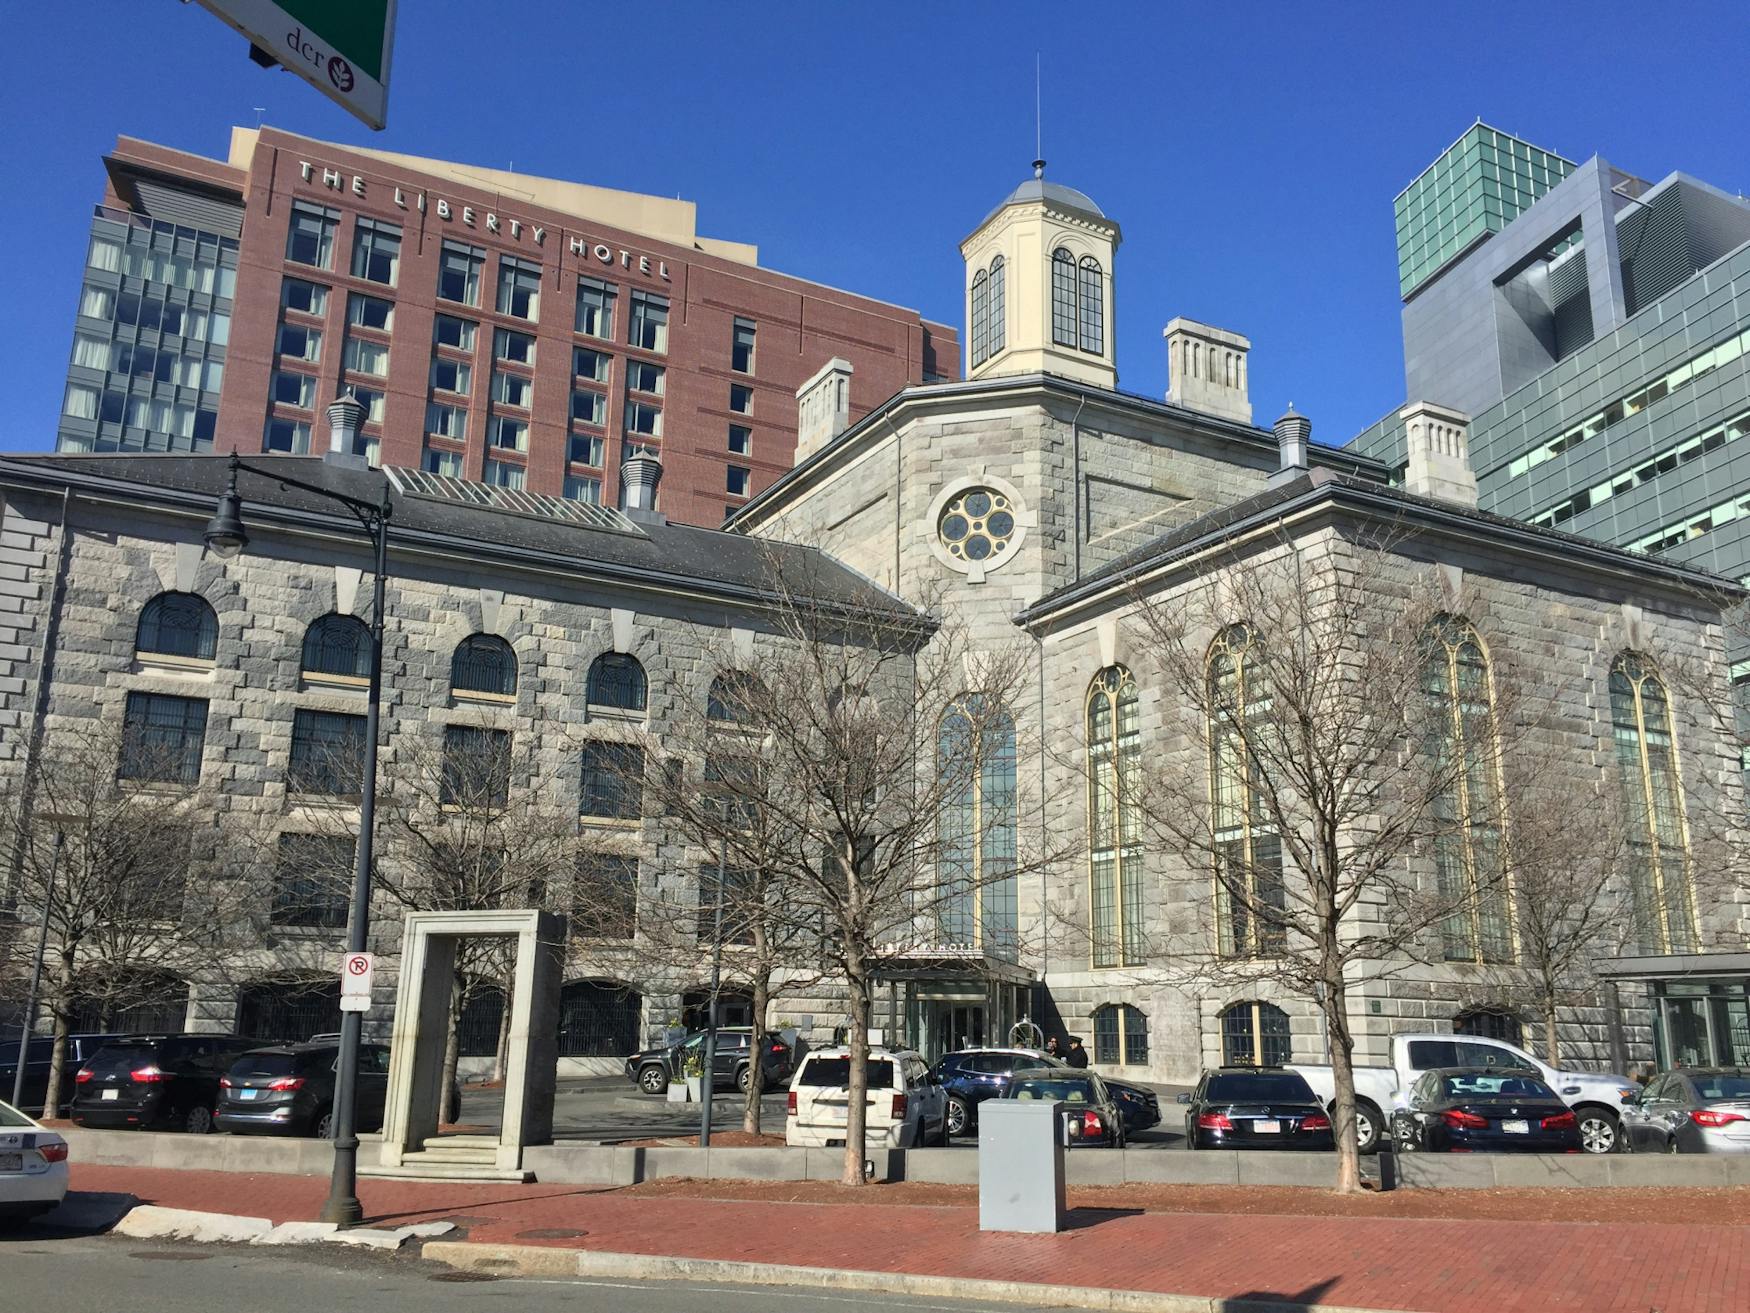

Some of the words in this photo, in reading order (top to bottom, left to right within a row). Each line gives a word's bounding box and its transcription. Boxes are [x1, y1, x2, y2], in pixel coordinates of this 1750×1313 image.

[287, 27, 325, 68] dcr
[299, 160, 365, 194] THE
[395, 187, 547, 244] LIBERTY
[569, 236, 669, 279] HOTEL
